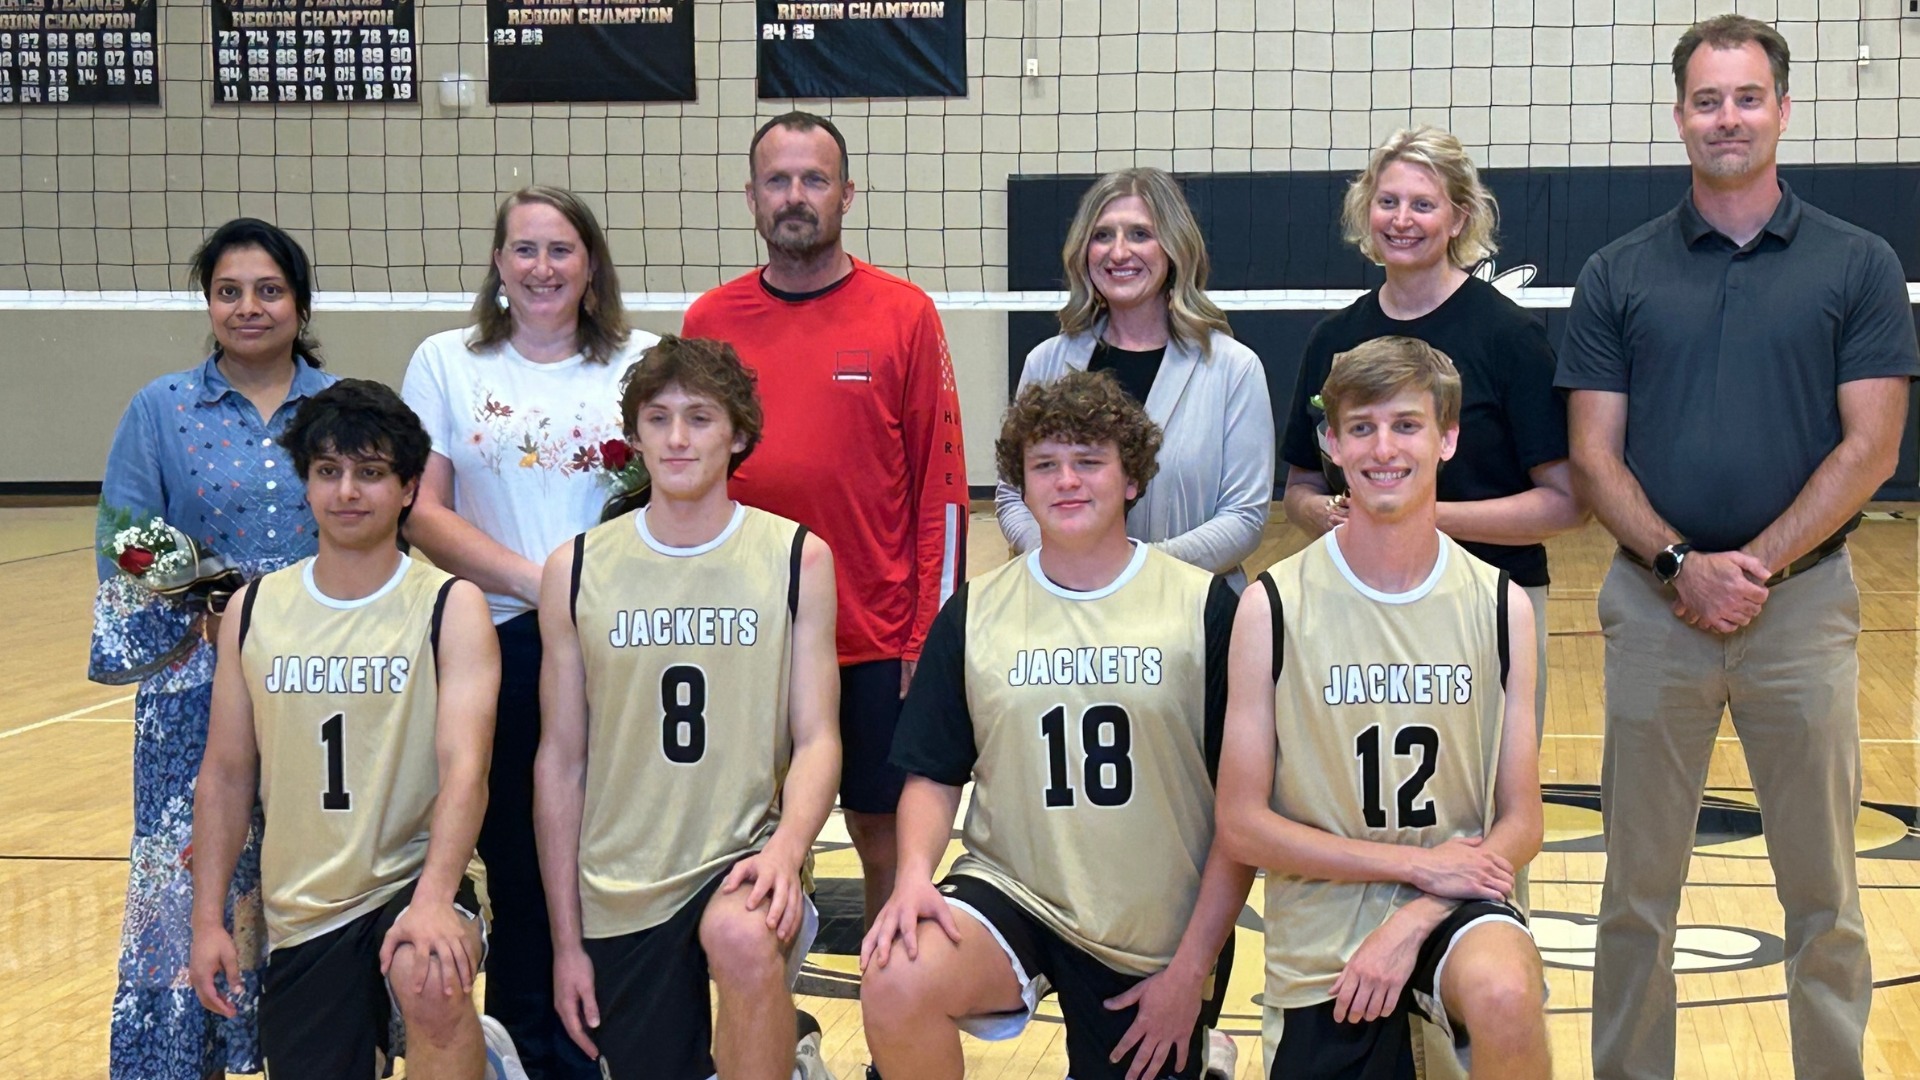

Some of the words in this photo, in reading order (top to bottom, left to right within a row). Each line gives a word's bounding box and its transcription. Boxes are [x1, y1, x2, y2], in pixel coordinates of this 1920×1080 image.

[232, 11, 297, 27] REGION
[300, 10, 394, 26] CHAMPION
[508, 9, 574, 25] REGION
[578, 7, 673, 24] CHAMPION
[778, 4, 844, 20] REGION
[848, 2, 944, 19] CHAMPION
[0, 14, 41, 29] GION
[45, 13, 136, 29] CHAMPION
[219, 31, 240, 46] 73
[246, 31, 269, 46] 74
[276, 31, 296, 46] 75
[303, 30, 325, 46] 76
[331, 30, 352, 45] 77
[360, 30, 381, 45] 78
[388, 29, 410, 44] 79
[494, 28, 516, 45] 23
[763, 23, 785, 40] 24
[792, 23, 814, 40] 25
[0, 50, 13, 67] 2
[19, 50, 41, 67] 04
[48, 50, 69, 67] 05
[77, 50, 98, 67] 06
[104, 50, 125, 67] 07
[390, 47, 412, 63] 90
[304, 66, 327, 82] 04
[362, 66, 384, 81] 06
[391, 66, 412, 81] 07
[0, 86, 13, 102] 3
[223, 85, 238, 101] 11
[251, 85, 269, 101] 12
[305, 85, 323, 101] 16
[365, 84, 383, 99] 18
[393, 83, 411, 99] 19
[608, 607, 758, 648] JACKETS
[265, 655, 410, 694] JACKETS
[1008, 646, 1162, 686] JACKETS
[1323, 664, 1473, 705] JACKETS
[660, 663, 708, 766] 8
[320, 711, 351, 811] 1
[1040, 702, 1134, 809] 18
[1354, 723, 1440, 830] 12
